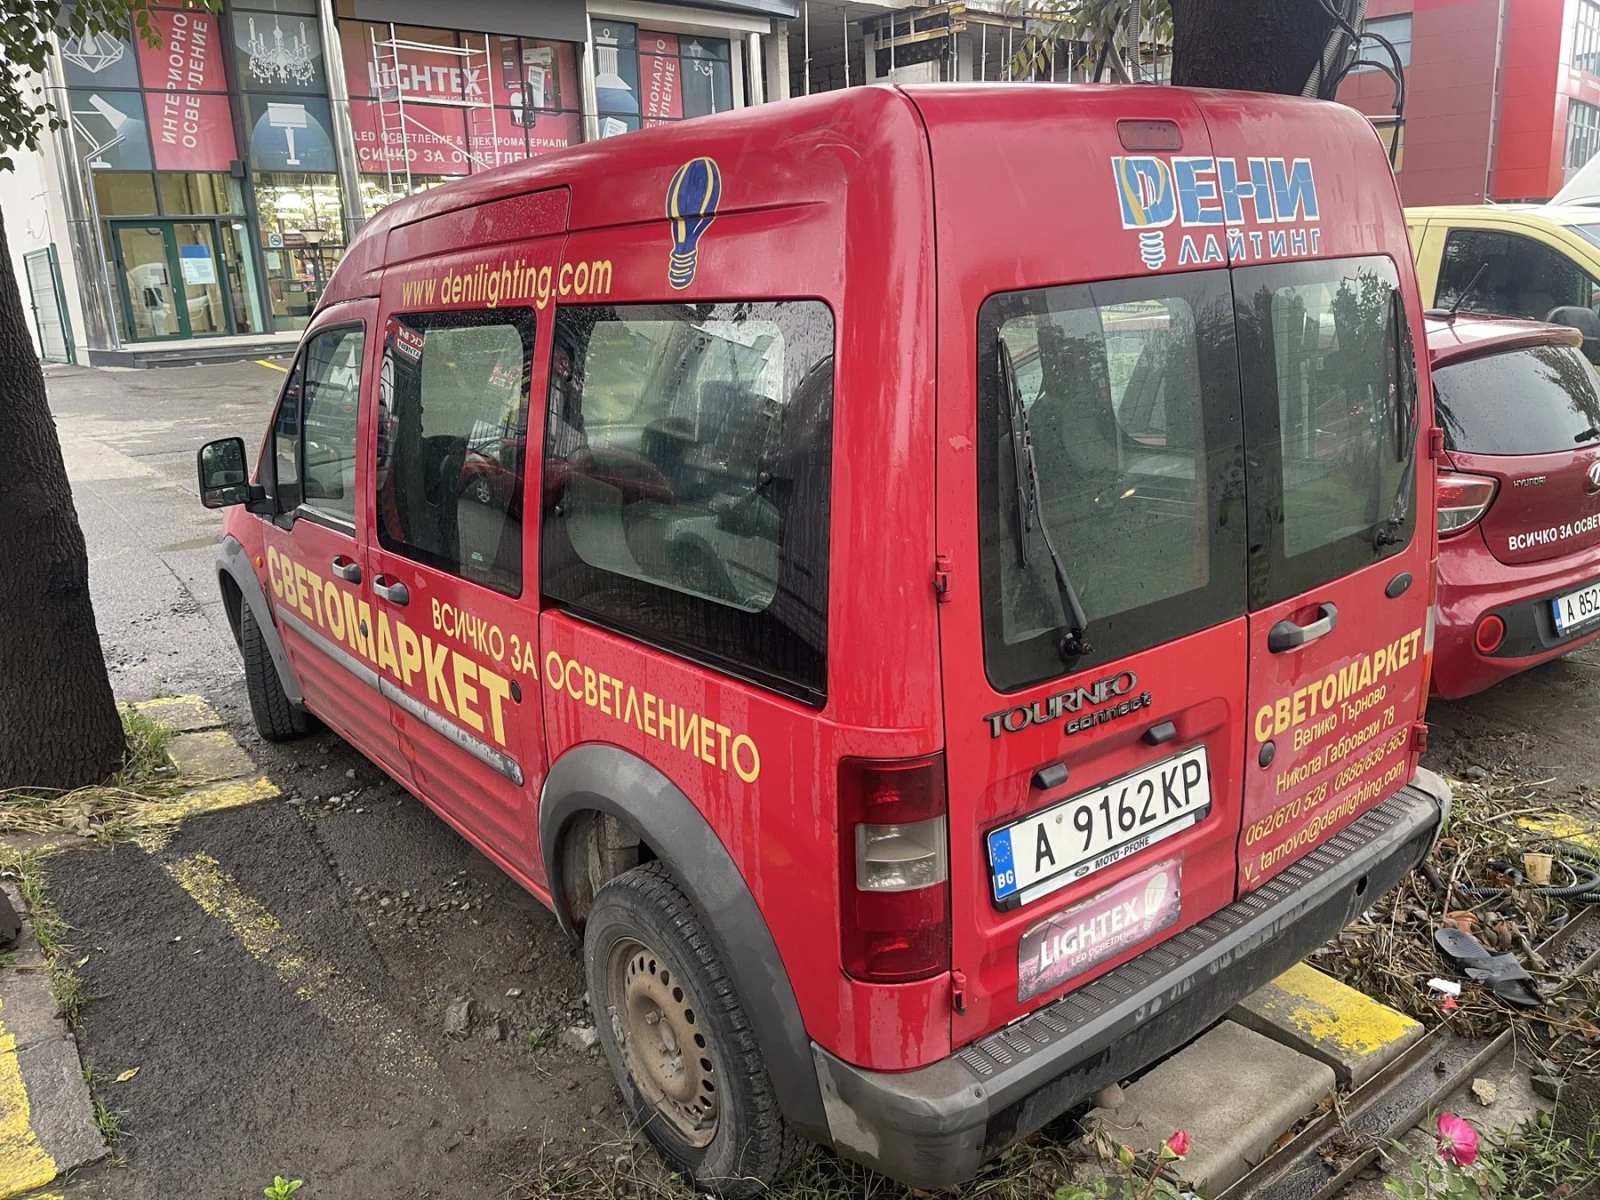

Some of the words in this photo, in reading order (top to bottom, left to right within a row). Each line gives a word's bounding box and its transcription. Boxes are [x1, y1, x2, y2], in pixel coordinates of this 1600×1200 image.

[367, 61, 483, 105] LIGHTEX
[354, 131, 376, 142] LED
[456, 136, 463, 145] &
[424, 150, 445, 163] ЗА
[1177, 227, 1322, 266] ЛАЙТИНГ
[441, 259, 613, 310] denilighting.com
[1508, 527, 1557, 551] ВСИЧКО
[1559, 523, 1573, 539] ЗА
[1578, 588, 1600, 616] 852
[267, 544, 511, 747] СВЕТОМАРКЕТ
[431, 597, 505, 662] ВСИЧКО
[509, 633, 539, 681] ЗА
[545, 651, 761, 784] ОСВЕТЛЕНИЕТО
[983, 669, 1138, 739] TOURNEO
[1254, 626, 1423, 743] СВЕТОМАРКЕТ
[1064, 690, 1153, 736] connect
[1293, 713, 1338, 752] Велико
[1340, 684, 1387, 724] Търново
[1276, 756, 1322, 795] Никола
[1324, 721, 1381, 766] Габровски
[1382, 705, 1395, 730] 78
[1245, 797, 1301, 847] 062/670
[1303, 781, 1328, 811] 528
[1334, 743, 1386, 793] 0886/838
[996, 869, 1015, 889] BG
[1039, 896, 1141, 972] LIGHTEX
[1071, 952, 1088, 966] LED
